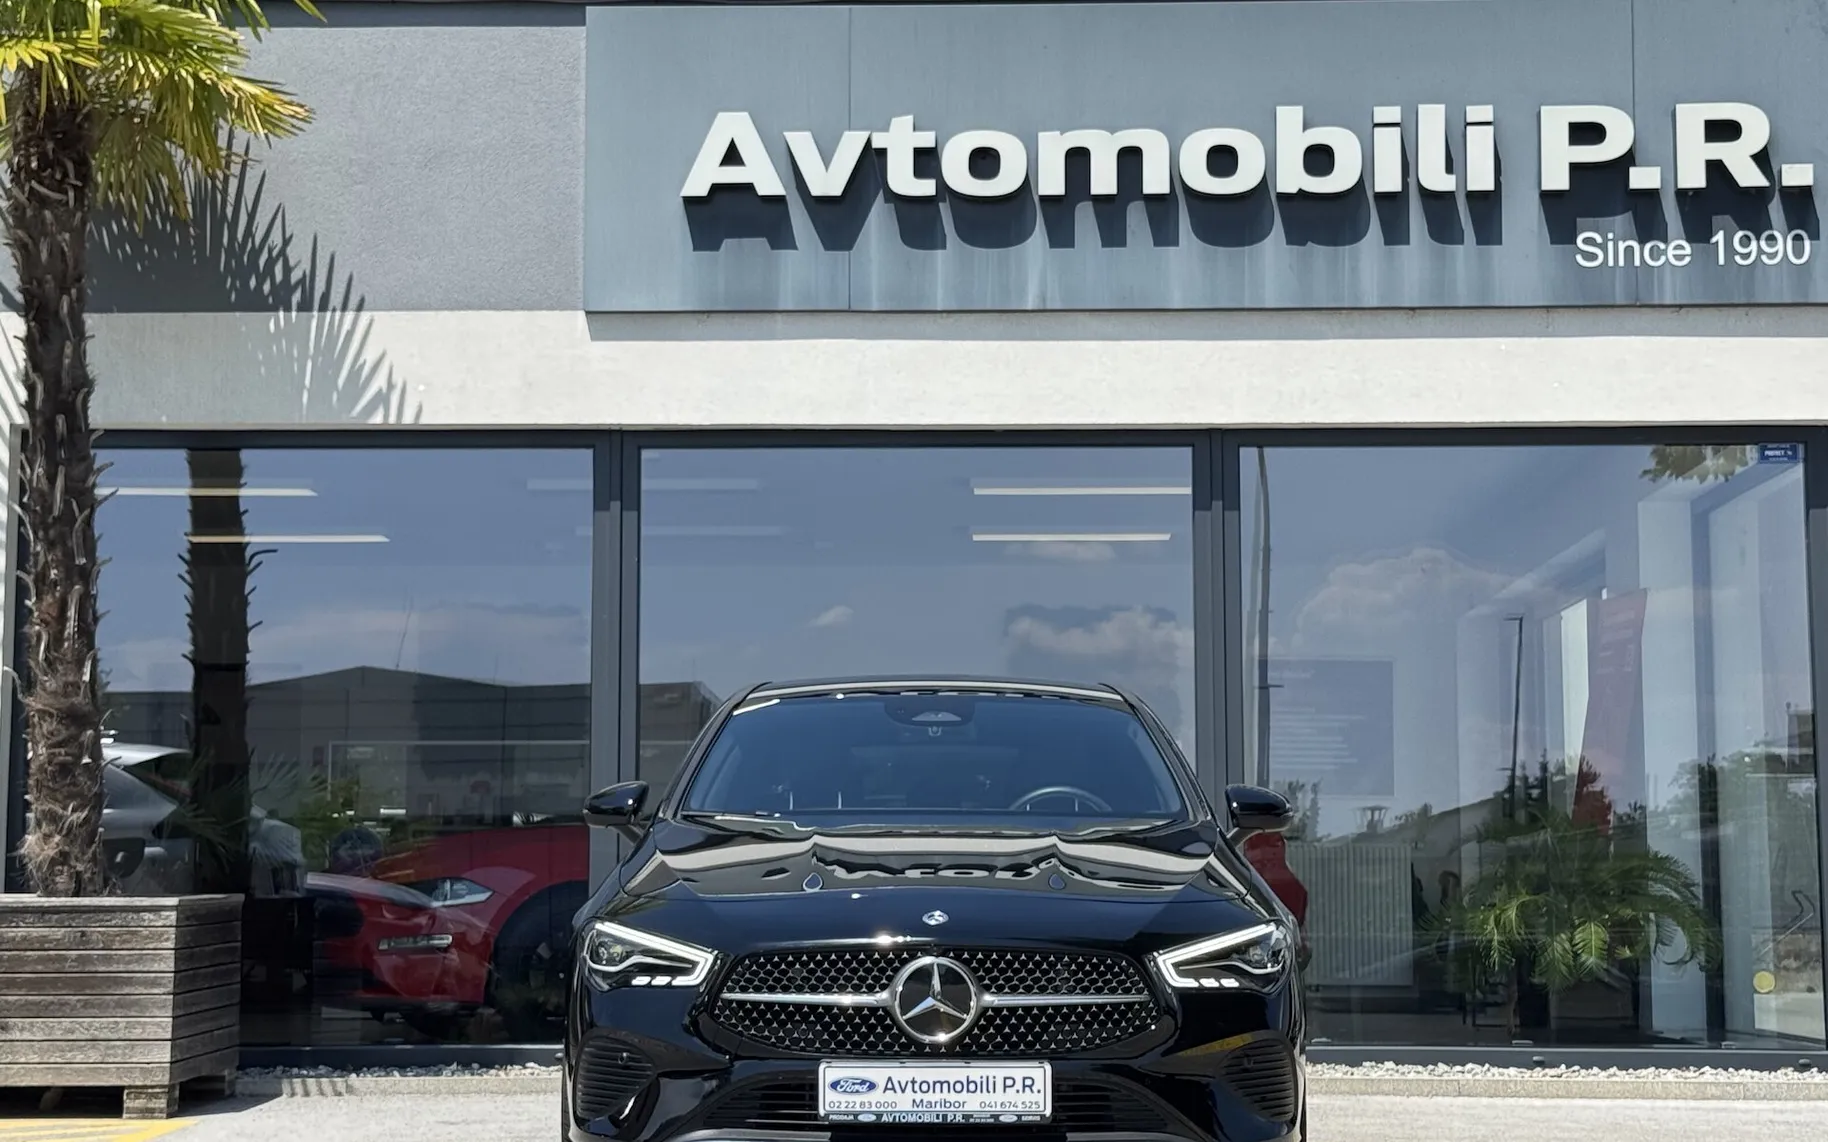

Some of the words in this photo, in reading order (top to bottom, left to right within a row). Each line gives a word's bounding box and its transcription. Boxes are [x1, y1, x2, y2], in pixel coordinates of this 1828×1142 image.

[680, 104, 1495, 197] Avtomobili
[1540, 102, 1814, 192] P.R.
[1574, 231, 1692, 267] Since
[1711, 229, 1812, 267] 1990
[836, 1078, 870, 1093] Ford
[883, 1075, 996, 1094] Avtomobili
[1003, 1076, 1041, 1094] P.R.
[828, 1100, 842, 1109] 02
[844, 1100, 857, 1109] 22
[859, 1100, 872, 1109] 83
[875, 1100, 897, 1109] 000
[912, 1098, 967, 1109] Maribor
[980, 1101, 997, 1109] 041
[1000, 1101, 1018, 1109] 674
[1021, 1101, 1040, 1109] 525
[881, 1113, 942, 1123] AVTOMOBILI
